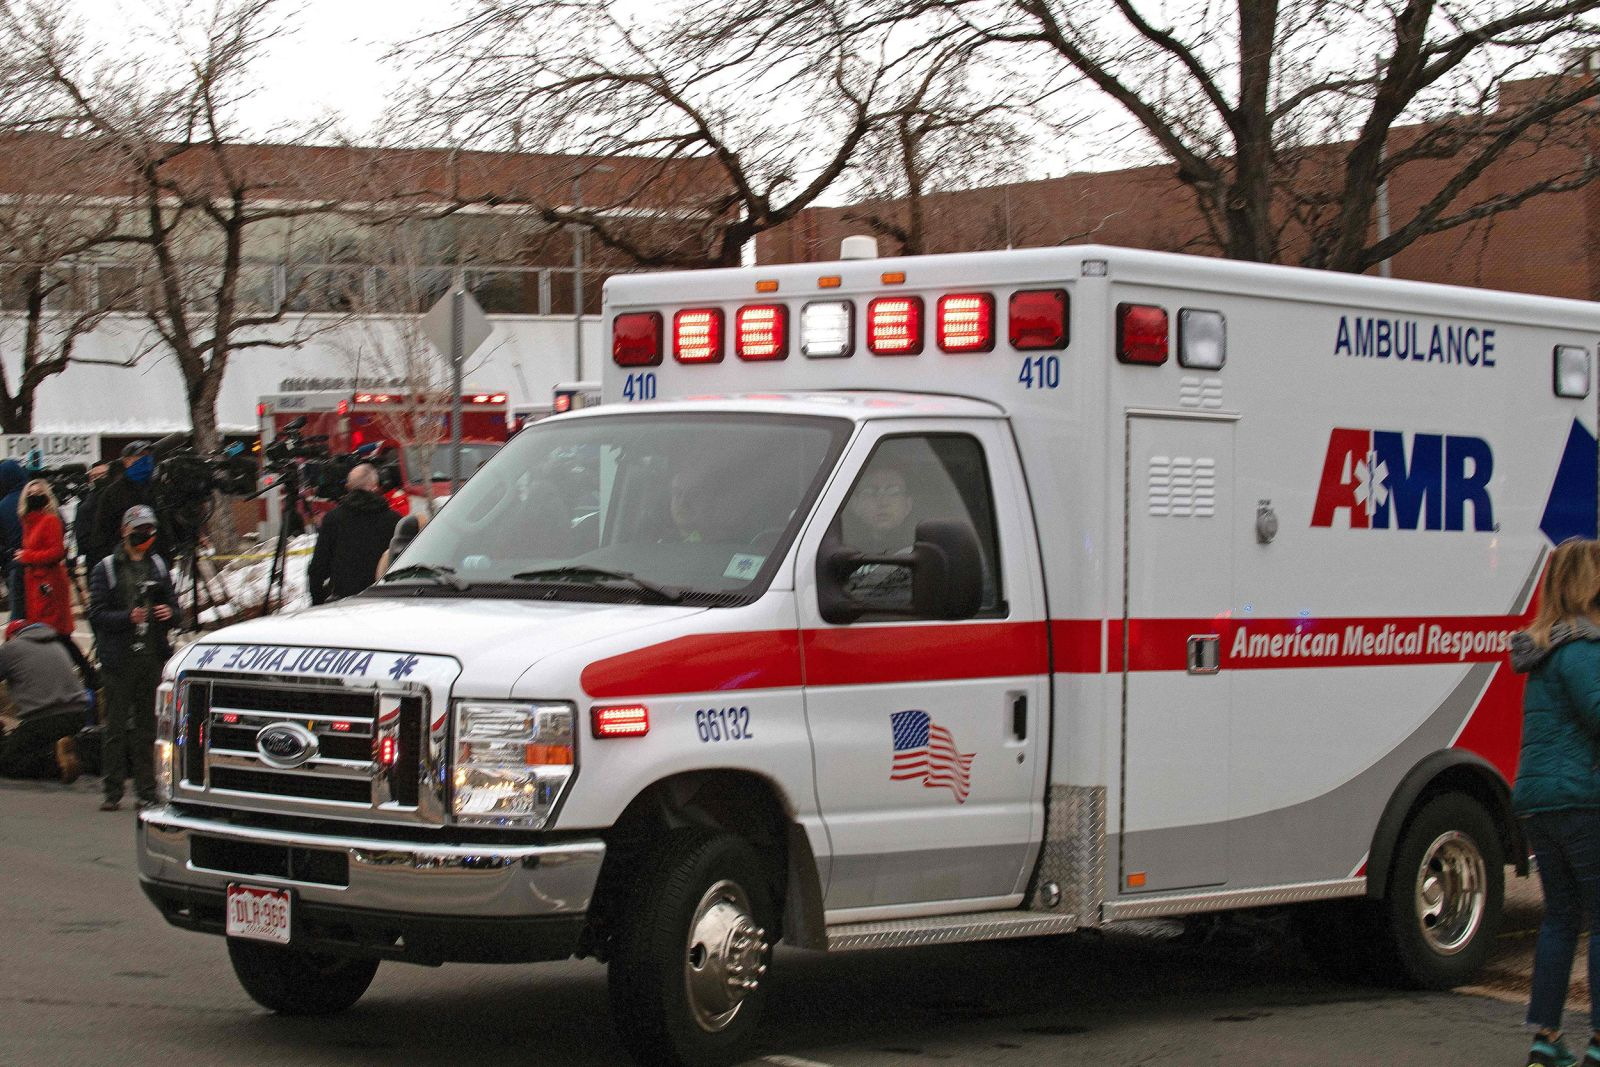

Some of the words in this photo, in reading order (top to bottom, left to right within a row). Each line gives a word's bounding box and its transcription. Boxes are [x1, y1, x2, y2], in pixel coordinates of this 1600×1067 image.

[1334, 315, 1497, 367] AMBULANCE
[623, 373, 657, 401] 410
[1018, 356, 1060, 389] 410
[6, 437, 39, 457] FOR
[43, 435, 92, 455] LEASE
[1309, 427, 1495, 532] AMR
[1230, 626, 1340, 659] American
[1341, 624, 1425, 657] Medical
[695, 706, 754, 742] 66132
